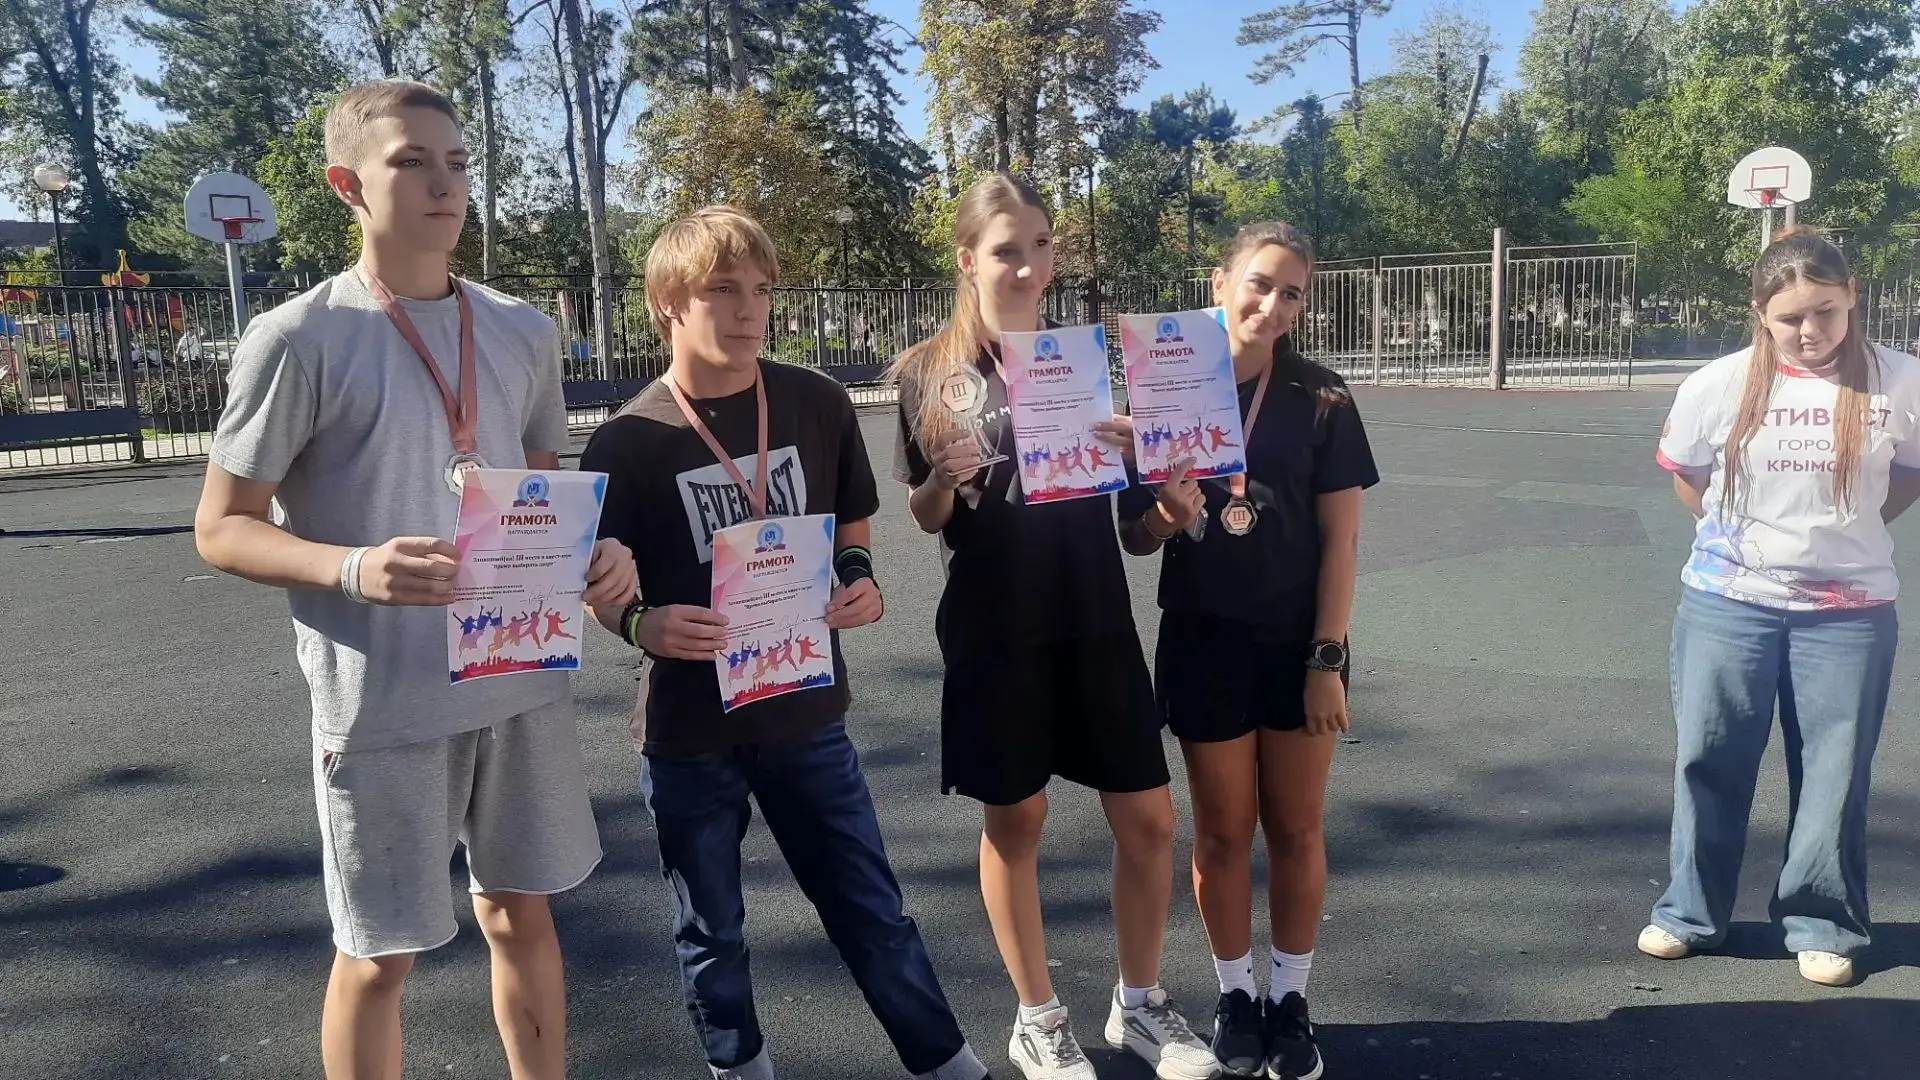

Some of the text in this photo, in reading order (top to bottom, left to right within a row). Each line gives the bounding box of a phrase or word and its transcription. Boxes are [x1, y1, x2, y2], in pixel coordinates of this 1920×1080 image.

[1149, 347, 1194, 359] ГРАМОТА
[1029, 366, 1073, 378] ГРАМОТА
[950, 382, 967, 399] III
[1761, 408, 1892, 427] ТИВСТ
[1778, 439, 1835, 453] ГОРО
[1767, 460, 1836, 473] КРЫМС
[687, 456, 801, 548] EVERAST
[500, 514, 557, 526] ГРАМОТА
[1232, 511, 1246, 521] III
[746, 555, 795, 572] ГРАМОТА
